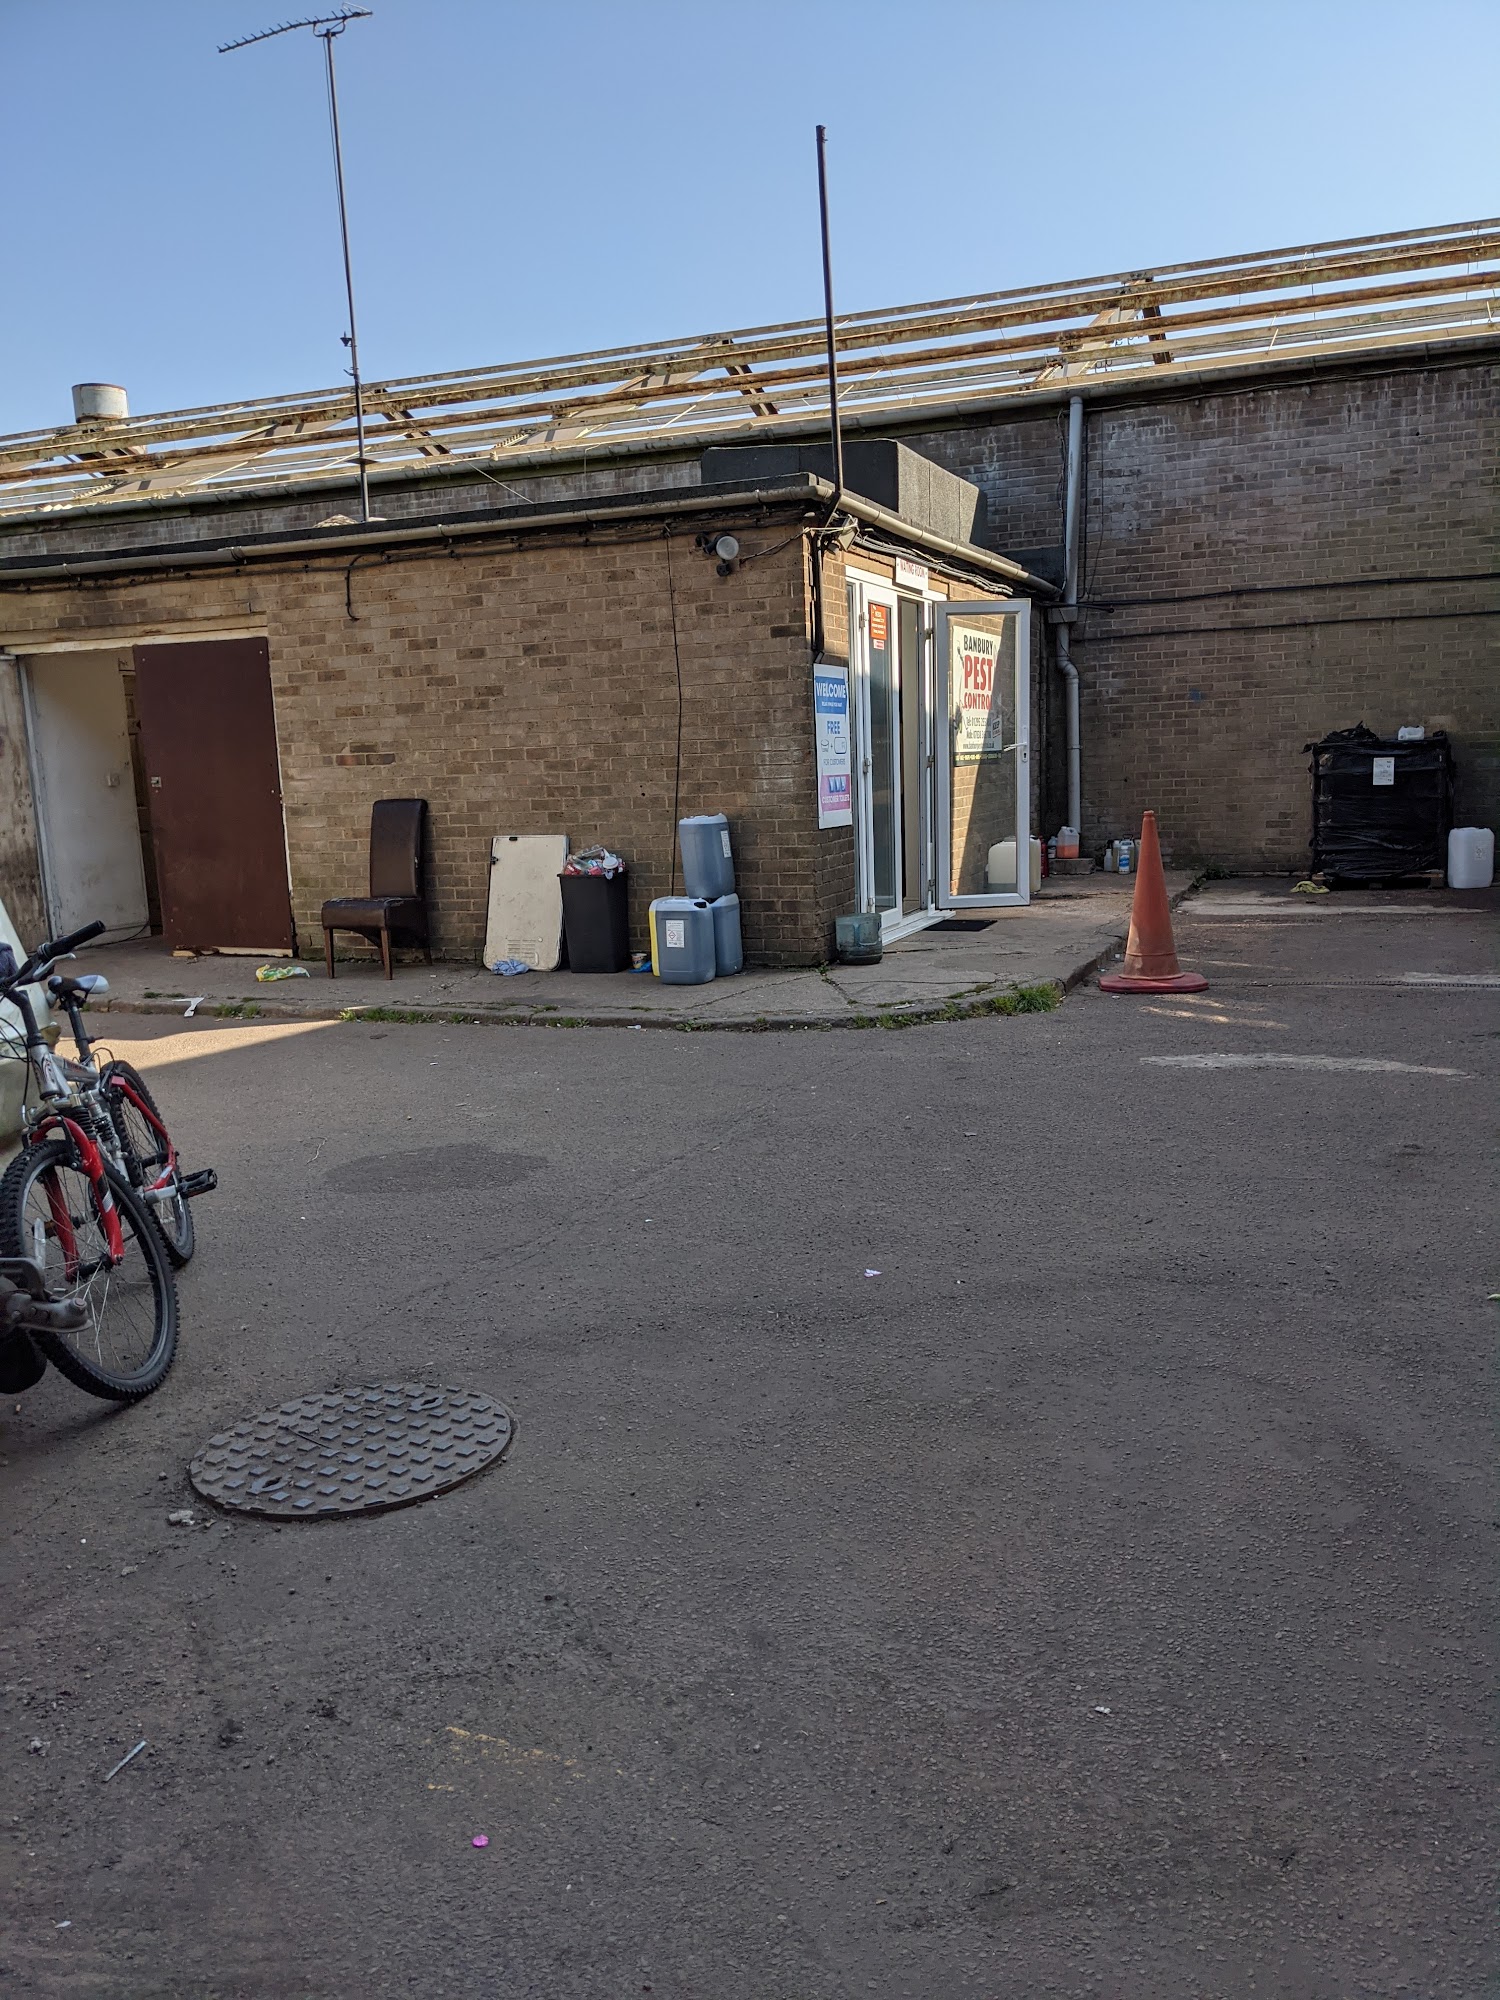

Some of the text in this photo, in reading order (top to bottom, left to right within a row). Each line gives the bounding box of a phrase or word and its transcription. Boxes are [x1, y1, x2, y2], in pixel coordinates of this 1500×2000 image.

[963, 634, 994, 656] BANBURY
[964, 654, 993, 692] PEST
[816, 682, 846, 699] WELCOME
[826, 720, 841, 735] FREE
